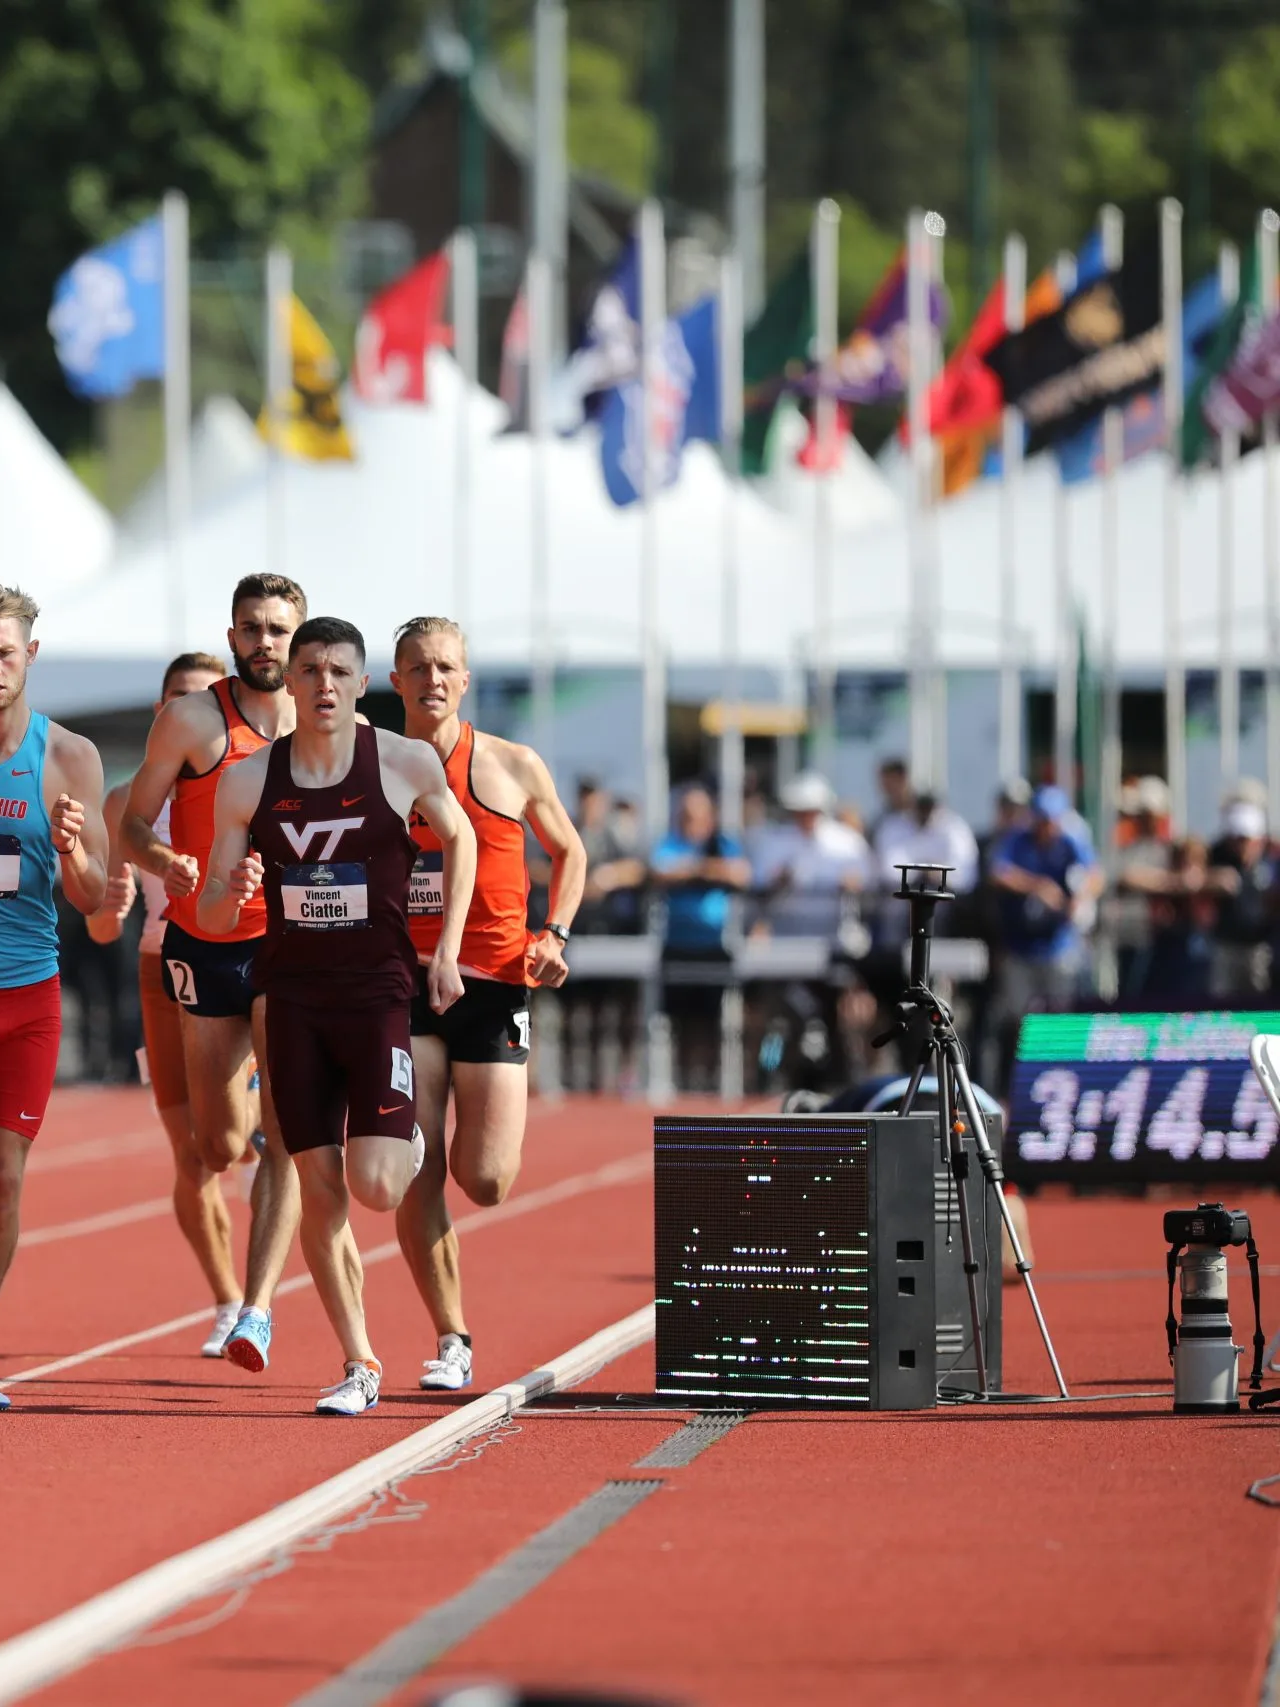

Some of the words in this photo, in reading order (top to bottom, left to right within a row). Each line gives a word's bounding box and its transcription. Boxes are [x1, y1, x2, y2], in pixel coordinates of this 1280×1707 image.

[279, 816, 367, 861] VT
[305, 890, 341, 900] Vincent
[408, 888, 442, 903] ulson
[300, 902, 348, 919] Ciattei
[173, 961, 191, 1002] 2
[397, 1051, 410, 1092] 5
